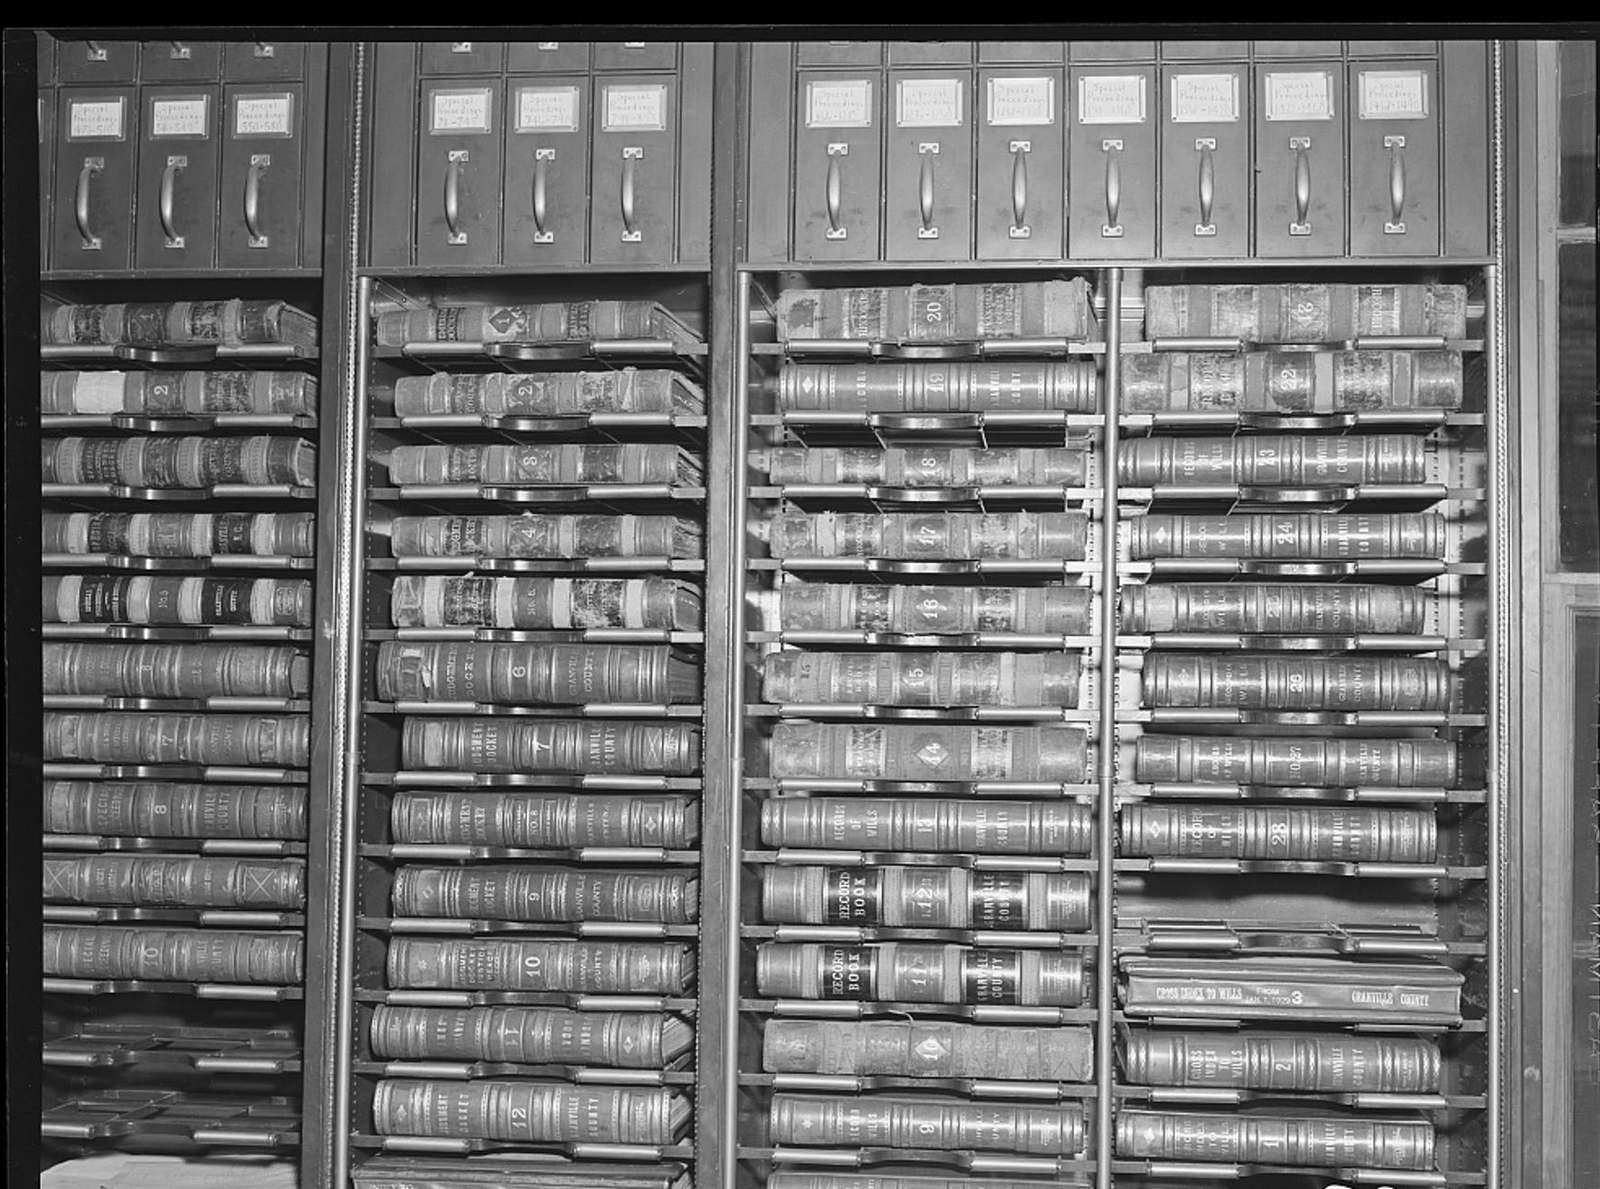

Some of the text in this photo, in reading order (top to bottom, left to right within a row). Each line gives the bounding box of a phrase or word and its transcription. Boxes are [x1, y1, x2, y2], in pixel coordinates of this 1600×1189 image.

[926, 301, 942, 322] 20
[154, 385, 169, 396] 2
[517, 385, 533, 395] 2
[1281, 369, 1298, 391] 22
[1259, 449, 1276, 466] 23
[1278, 521, 1294, 545] 24
[512, 665, 527, 678] 6
[904, 667, 925, 689] 15
[535, 741, 551, 752] 7
[155, 804, 167, 815] 8
[1271, 822, 1288, 846] 28
[528, 892, 542, 901] 9
[839, 872, 850, 920] RECORD
[854, 877, 866, 917] BOOK
[914, 887, 932, 910] 12
[143, 946, 159, 966] 10
[525, 956, 541, 978] 10
[832, 949, 844, 995] RECORD
[849, 953, 860, 991] BOOK
[910, 968, 929, 987] 11
[991, 957, 1003, 1000] COUNTY
[1156, 987, 1179, 1000] CROSS
[1206, 987, 1217, 1000] TO
[1219, 987, 1242, 1001] WILLS
[1291, 990, 1303, 1005] 3
[1351, 990, 1430, 1007] GRANVILLE COUNTY
[1190, 1050, 1203, 1080] CROSS
[1205, 1049, 1217, 1079] INDEX
[1219, 1056, 1230, 1072] TO
[1231, 1049, 1243, 1079] WILLS
[1276, 1063, 1292, 1072] 2
[1352, 1048, 1365, 1087] COUNTY
[512, 1107, 528, 1130] 12
[919, 1123, 935, 1135] 9
[1264, 1139, 1281, 1148] 1
